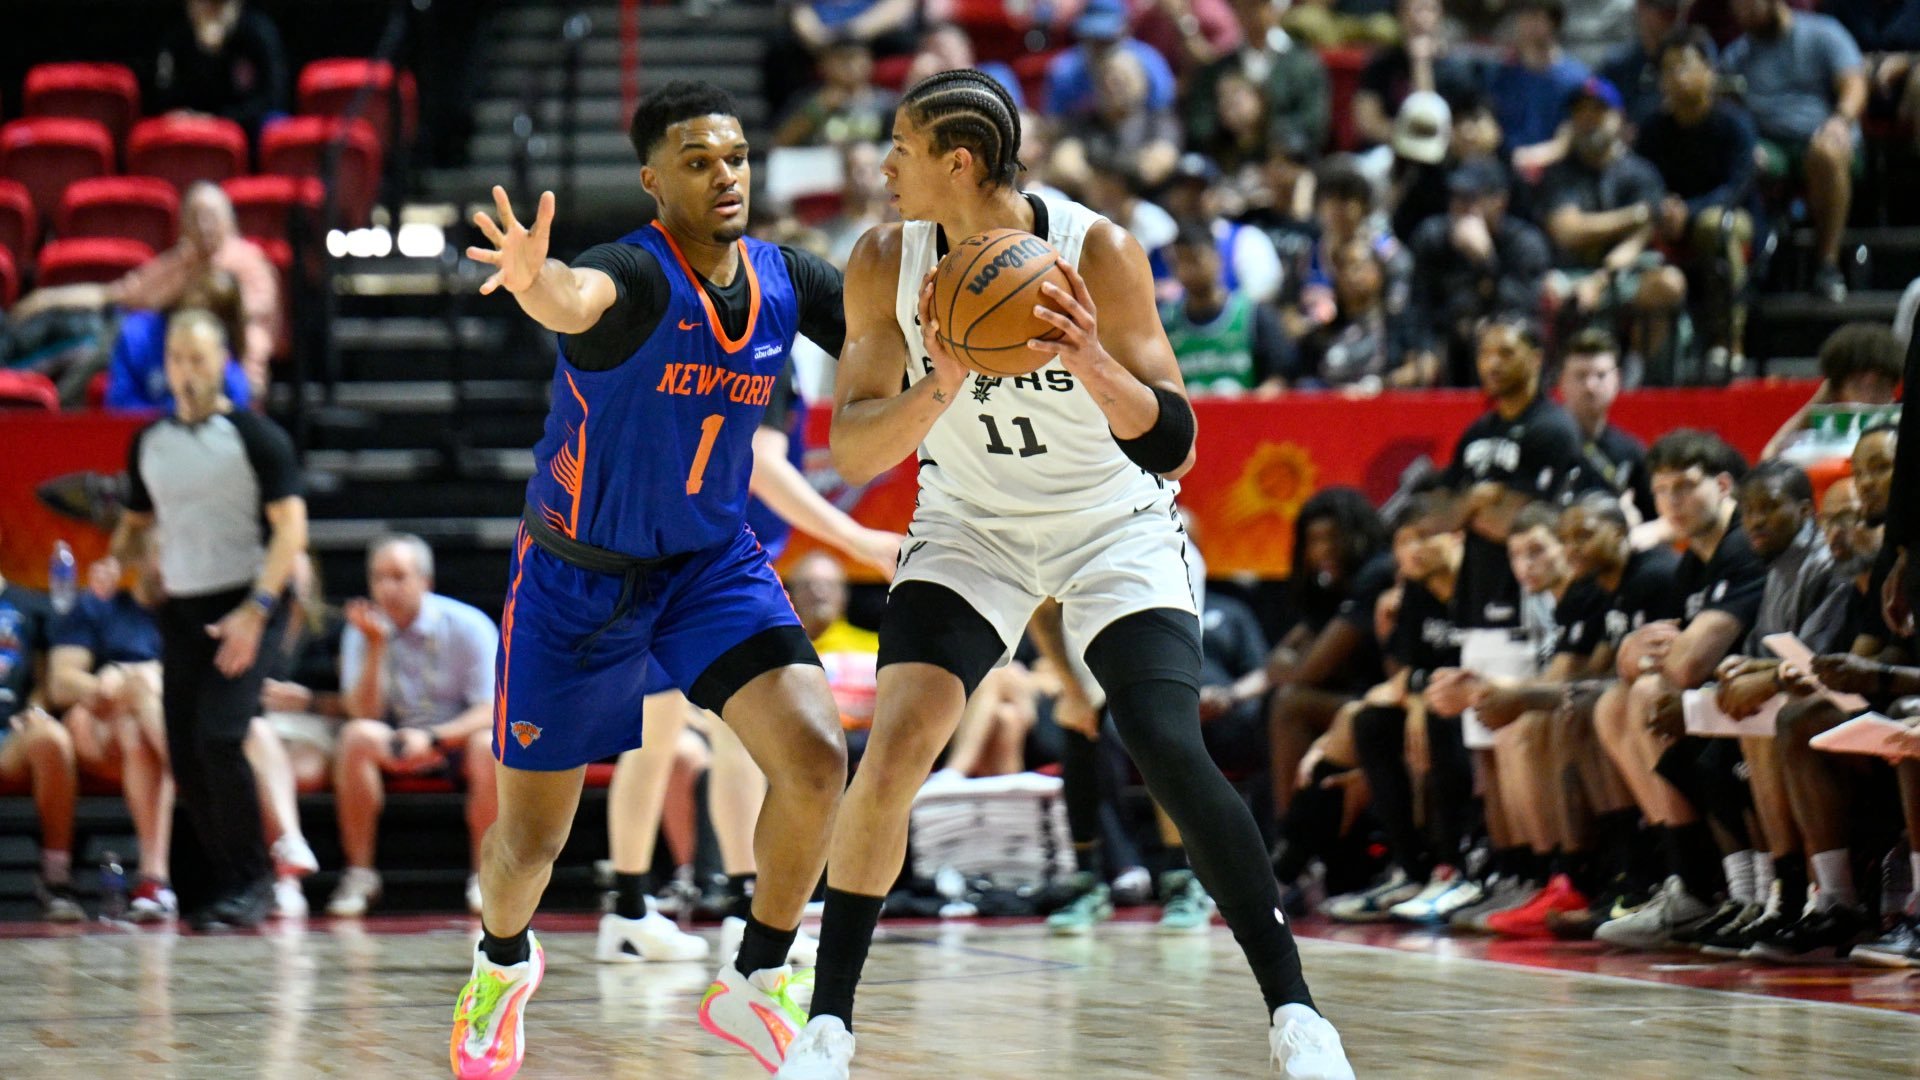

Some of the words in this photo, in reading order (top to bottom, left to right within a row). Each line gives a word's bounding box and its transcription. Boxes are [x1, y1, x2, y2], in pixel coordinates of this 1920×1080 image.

[965, 237, 1052, 296] Wilson
[656, 363, 726, 395] NEW
[719, 372, 776, 406] YORK
[686, 413, 726, 496] 1
[978, 413, 1048, 458] 11
